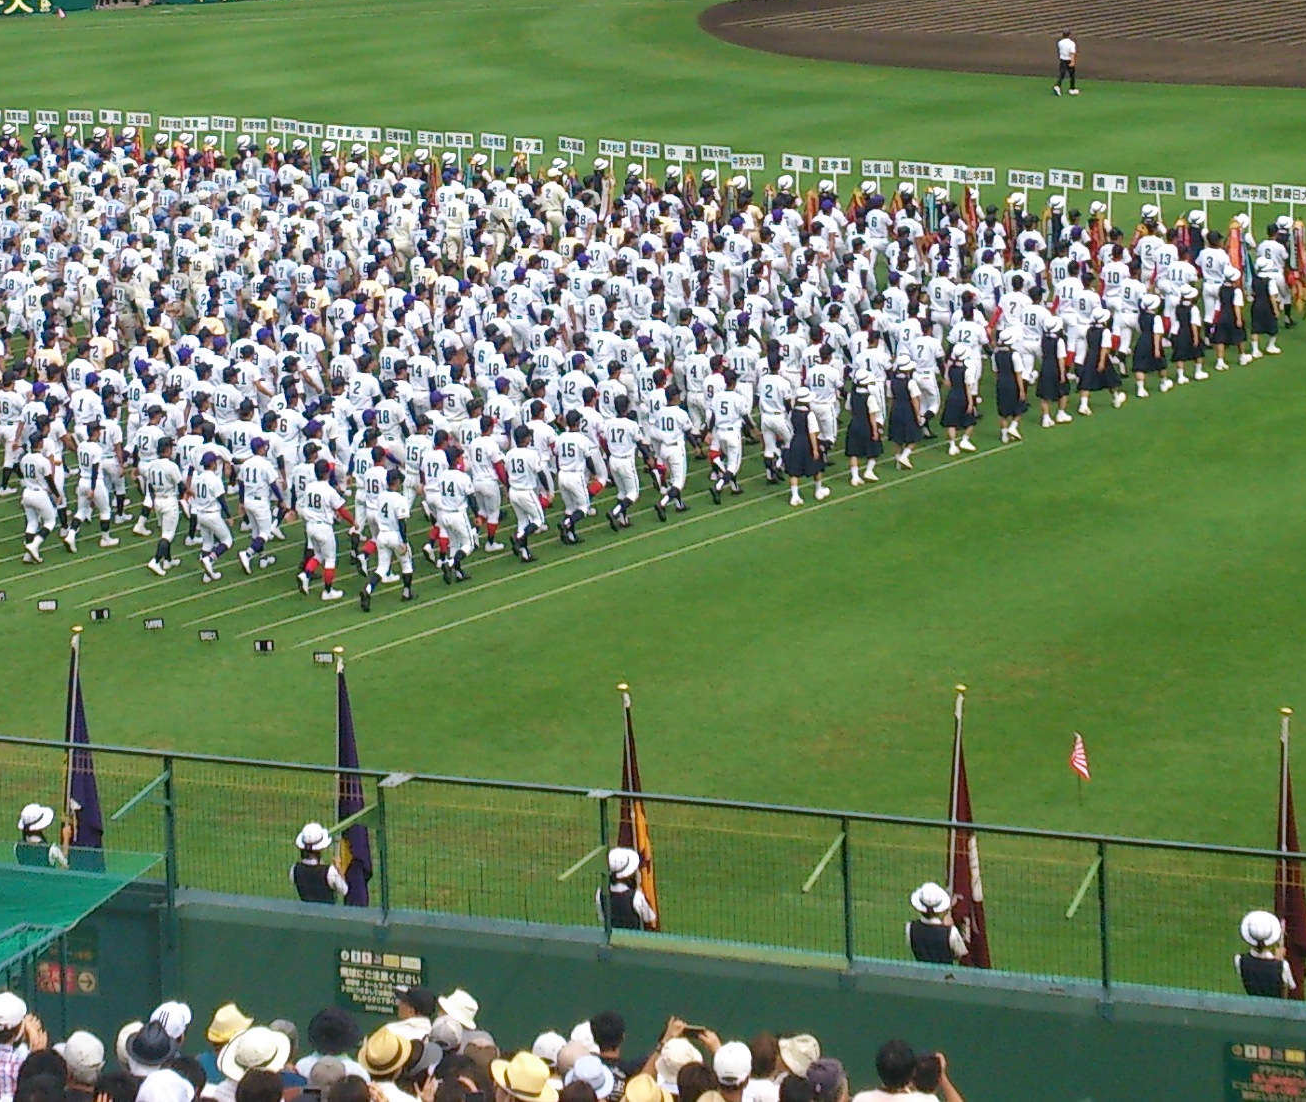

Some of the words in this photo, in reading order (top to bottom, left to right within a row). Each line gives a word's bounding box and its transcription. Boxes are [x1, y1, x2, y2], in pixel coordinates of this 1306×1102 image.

[958, 330, 971, 343] 12
[917, 345, 924, 358] 7
[37, 357, 48, 370] 14
[538, 355, 548, 368] 10
[733, 358, 745, 371] 11
[71, 368, 80, 381] 16
[690, 365, 697, 378] 4
[170, 374, 182, 387] 13
[353, 381, 361, 394] 2
[641, 377, 653, 391] 13
[813, 374, 825, 387] 16
[564, 381, 575, 395] 12
[707, 385, 714, 399] 9
[765, 385, 772, 398] 2
[215, 393, 227, 407] 13
[448, 394, 455, 407] 5
[603, 391, 609, 404] 6
[78, 399, 83, 412] 1
[721, 402, 728, 415] 5
[27, 411, 38, 425] 14
[377, 411, 389, 424] 18
[662, 417, 674, 431] 10
[280, 419, 287, 432] 6
[138, 435, 149, 450] 12
[234, 432, 246, 446] 14
[611, 429, 624, 443] 17
[406, 446, 418, 461] 15
[476, 448, 482, 462] 6
[562, 443, 575, 457] 15
[79, 452, 90, 467] 10
[511, 459, 524, 473] 13
[22, 464, 36, 479] 18
[246, 468, 257, 483] 11
[428, 463, 439, 477] 17
[152, 471, 163, 486] 11
[299, 476, 305, 491] 5
[197, 483, 206, 499] 10
[367, 479, 379, 494] 16
[442, 481, 455, 497] 14
[308, 493, 321, 509] 18
[381, 503, 388, 518] 4
